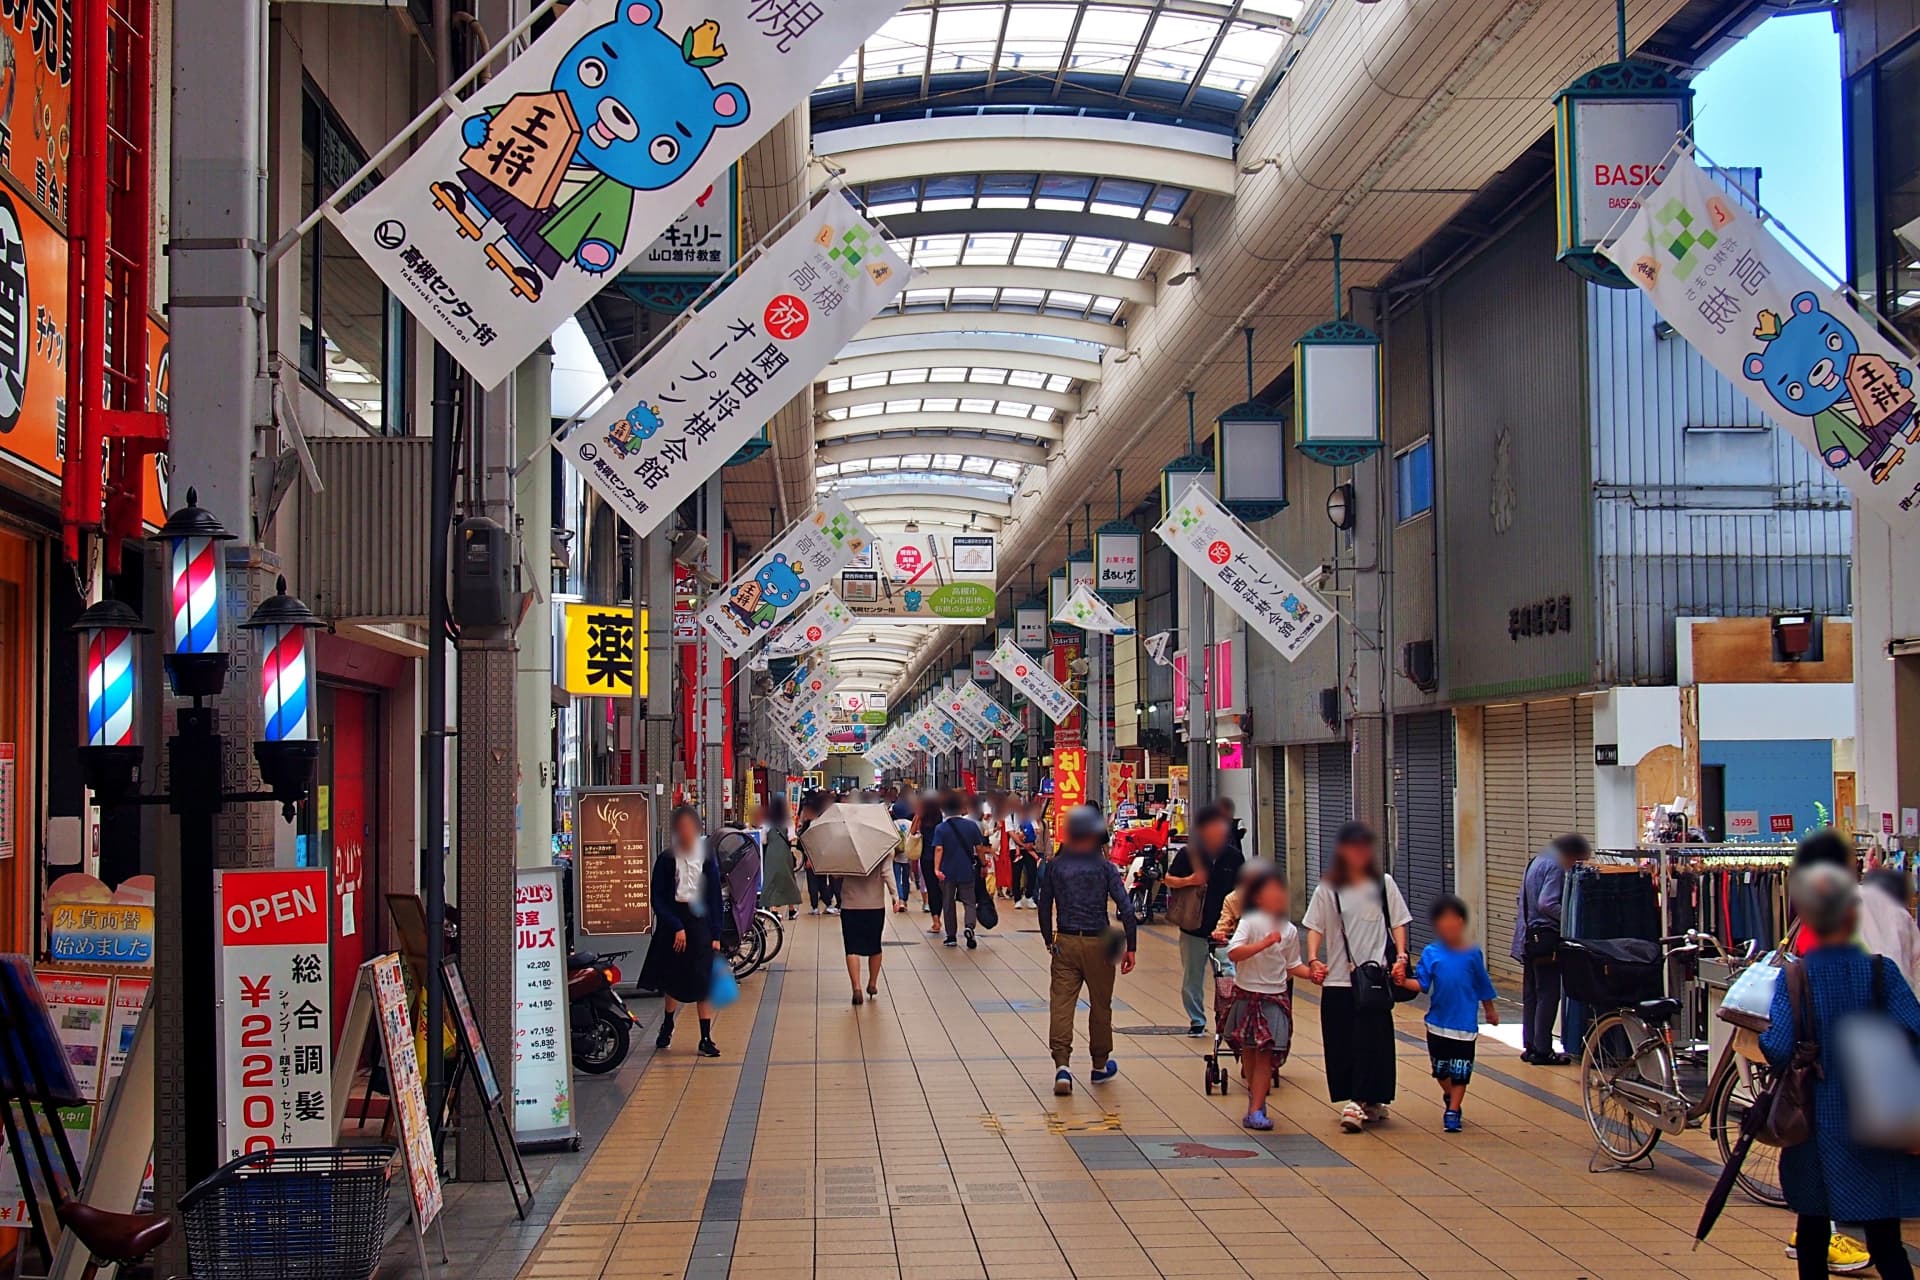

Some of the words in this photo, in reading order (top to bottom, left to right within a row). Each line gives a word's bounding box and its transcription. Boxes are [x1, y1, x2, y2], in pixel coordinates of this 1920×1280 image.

[488, 105, 557, 187] 王将
[1594, 164, 1666, 186] BASIC
[649, 250, 722, 262] 山口着付教室
[400, 268, 433, 304] Takatsuki
[400, 244, 498, 347] 高槻センター街
[788, 261, 843, 317] 高槻
[770, 301, 805, 338] 祝
[658, 317, 758, 404] オープン
[633, 342, 790, 491] 関西将棋会館
[593, 457, 649, 514] 高槻センター街
[795, 534, 832, 572] 高槻
[736, 584, 758, 608] 王将
[1772, 818, 1791, 828] SALE
[56, 909, 141, 931] 外貨両替
[227, 885, 317, 933] OPEN
[55, 937, 148, 958] 始めました
[291, 953, 325, 1121] 総合調髪
